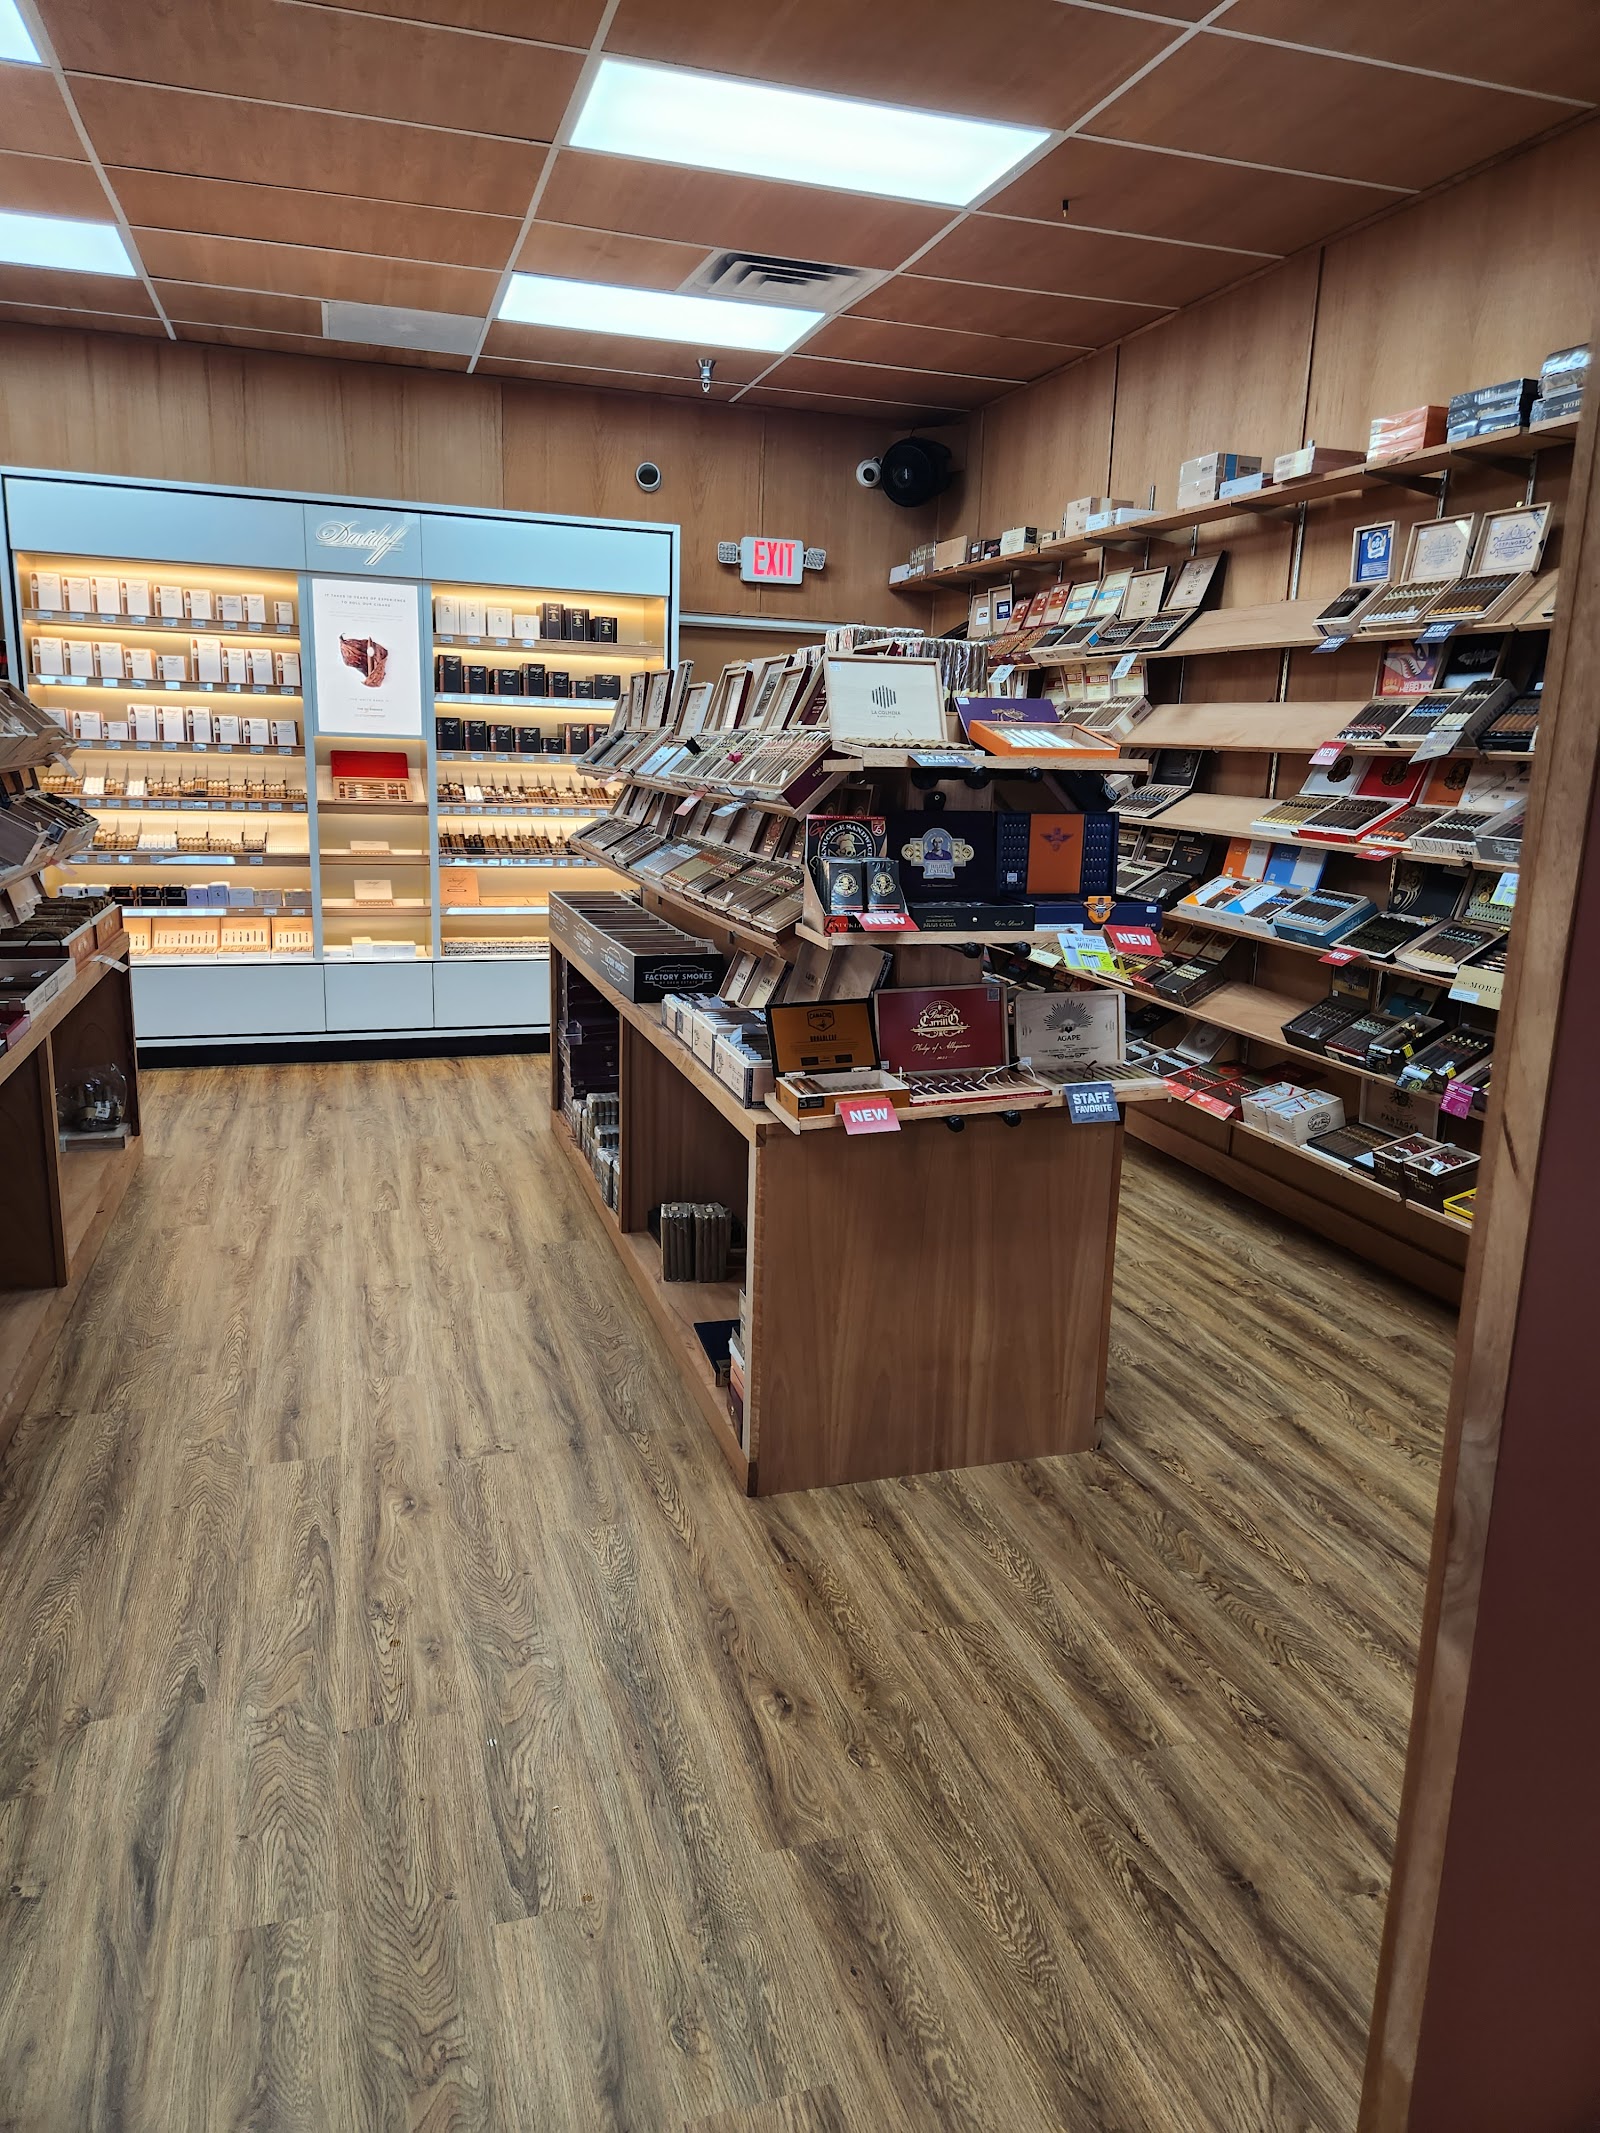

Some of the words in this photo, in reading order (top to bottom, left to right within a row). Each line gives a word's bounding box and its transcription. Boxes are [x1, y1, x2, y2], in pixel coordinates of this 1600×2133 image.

[316, 520, 408, 567] Davidoff
[753, 540, 796, 577] EXIT
[1317, 747, 1339, 757] NEW
[865, 917, 906, 925] NEW
[1116, 932, 1152, 946] NEW
[1328, 951, 1353, 961] NEW
[645, 973, 680, 981] FACTORY
[682, 972, 714, 980] SMOKES
[1469, 981, 1501, 995] MORT
[809, 1012, 833, 1020] CAMACHO
[1057, 1034, 1082, 1042] AGAPE
[1072, 1091, 1110, 1105] STAFF
[1075, 1103, 1114, 1114] FAVORITE
[849, 1107, 888, 1123] NEW
